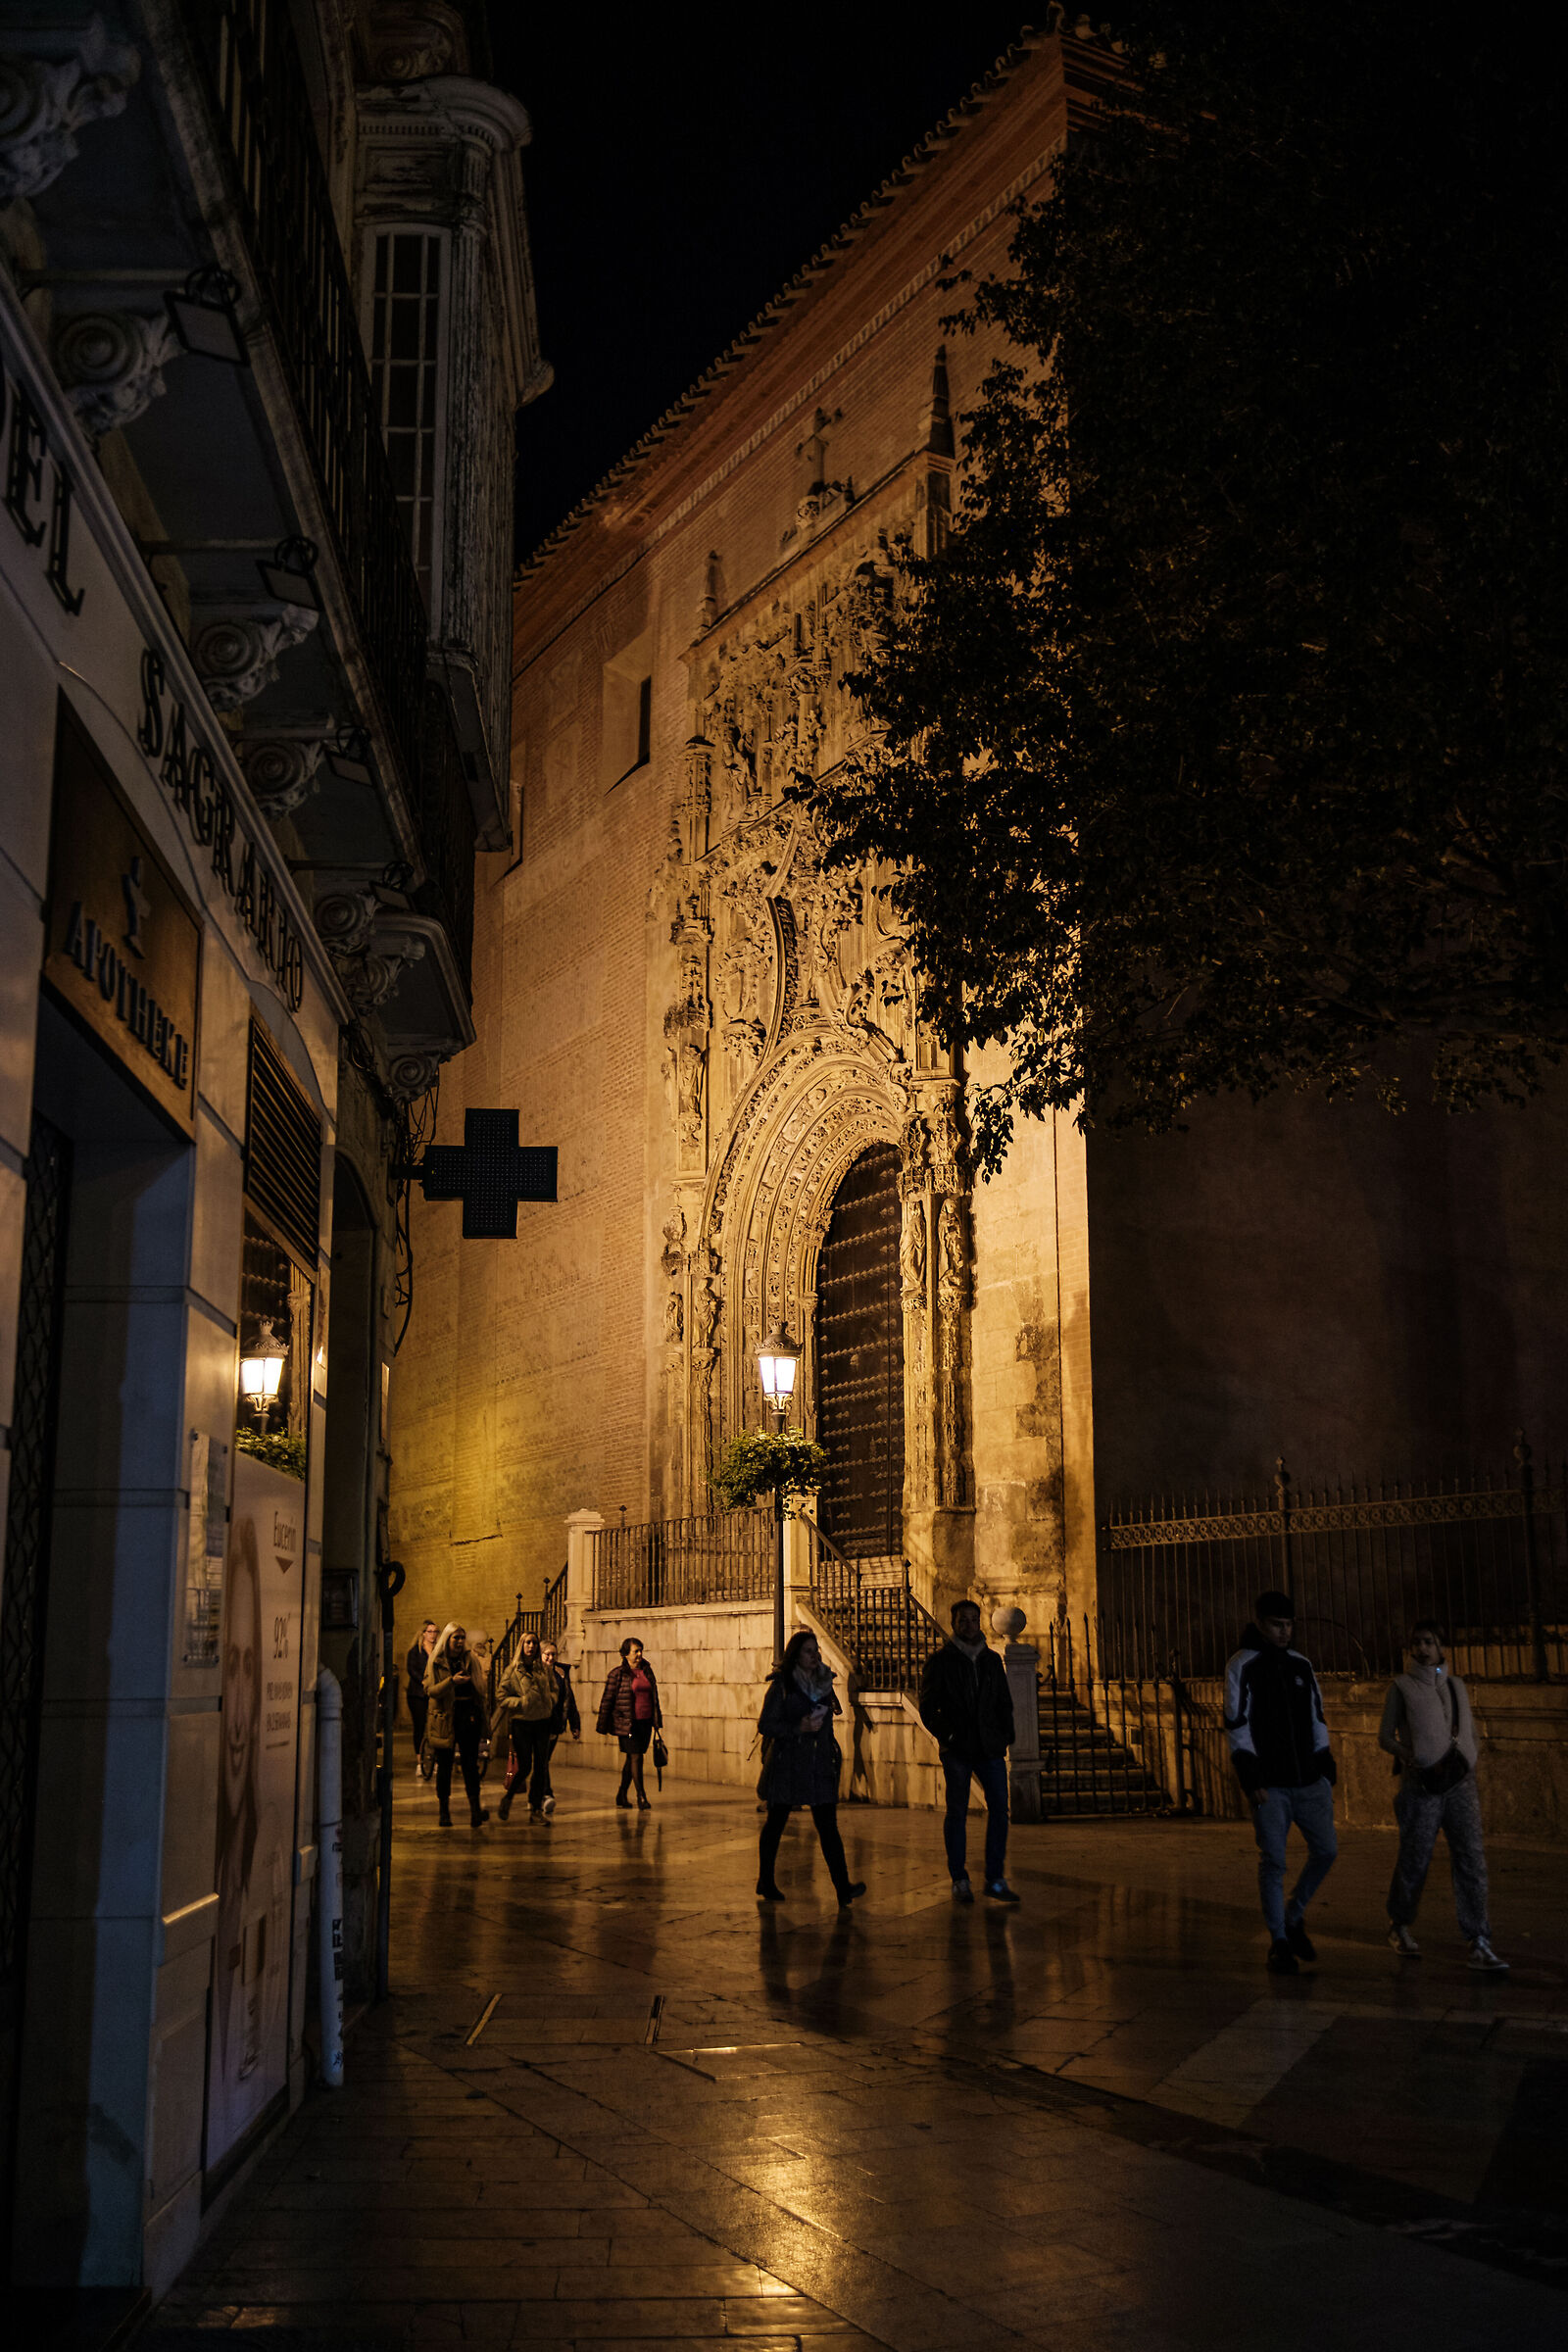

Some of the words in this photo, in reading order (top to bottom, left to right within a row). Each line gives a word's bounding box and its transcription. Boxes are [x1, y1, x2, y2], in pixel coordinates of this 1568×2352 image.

[0, 345, 84, 616] EL
[138, 649, 303, 1013] SAGRARIO
[62, 901, 188, 1091] APOTHEKE
